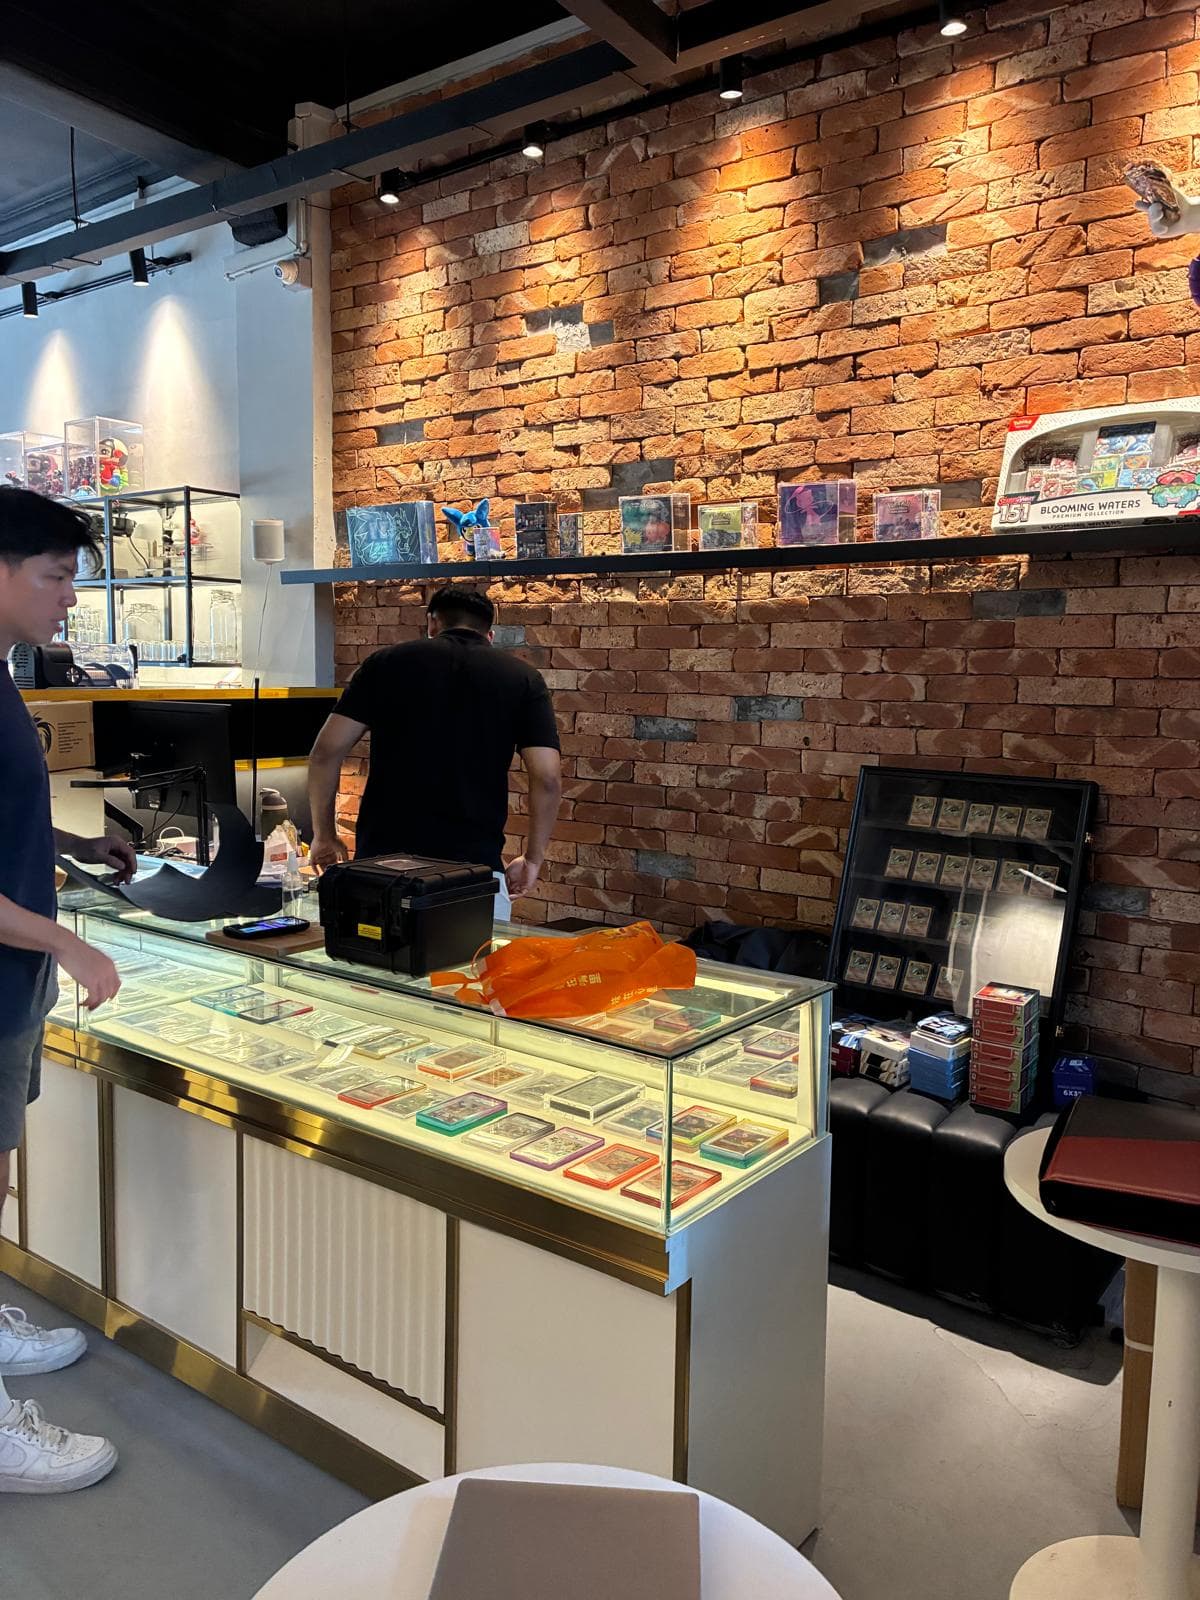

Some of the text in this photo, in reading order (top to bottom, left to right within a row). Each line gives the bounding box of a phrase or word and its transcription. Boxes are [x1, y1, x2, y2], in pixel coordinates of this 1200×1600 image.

[999, 502, 1031, 524] 151
[1040, 499, 1141, 515] BLOOMING WATERS
[1084, 509, 1125, 518] COLLECTION
